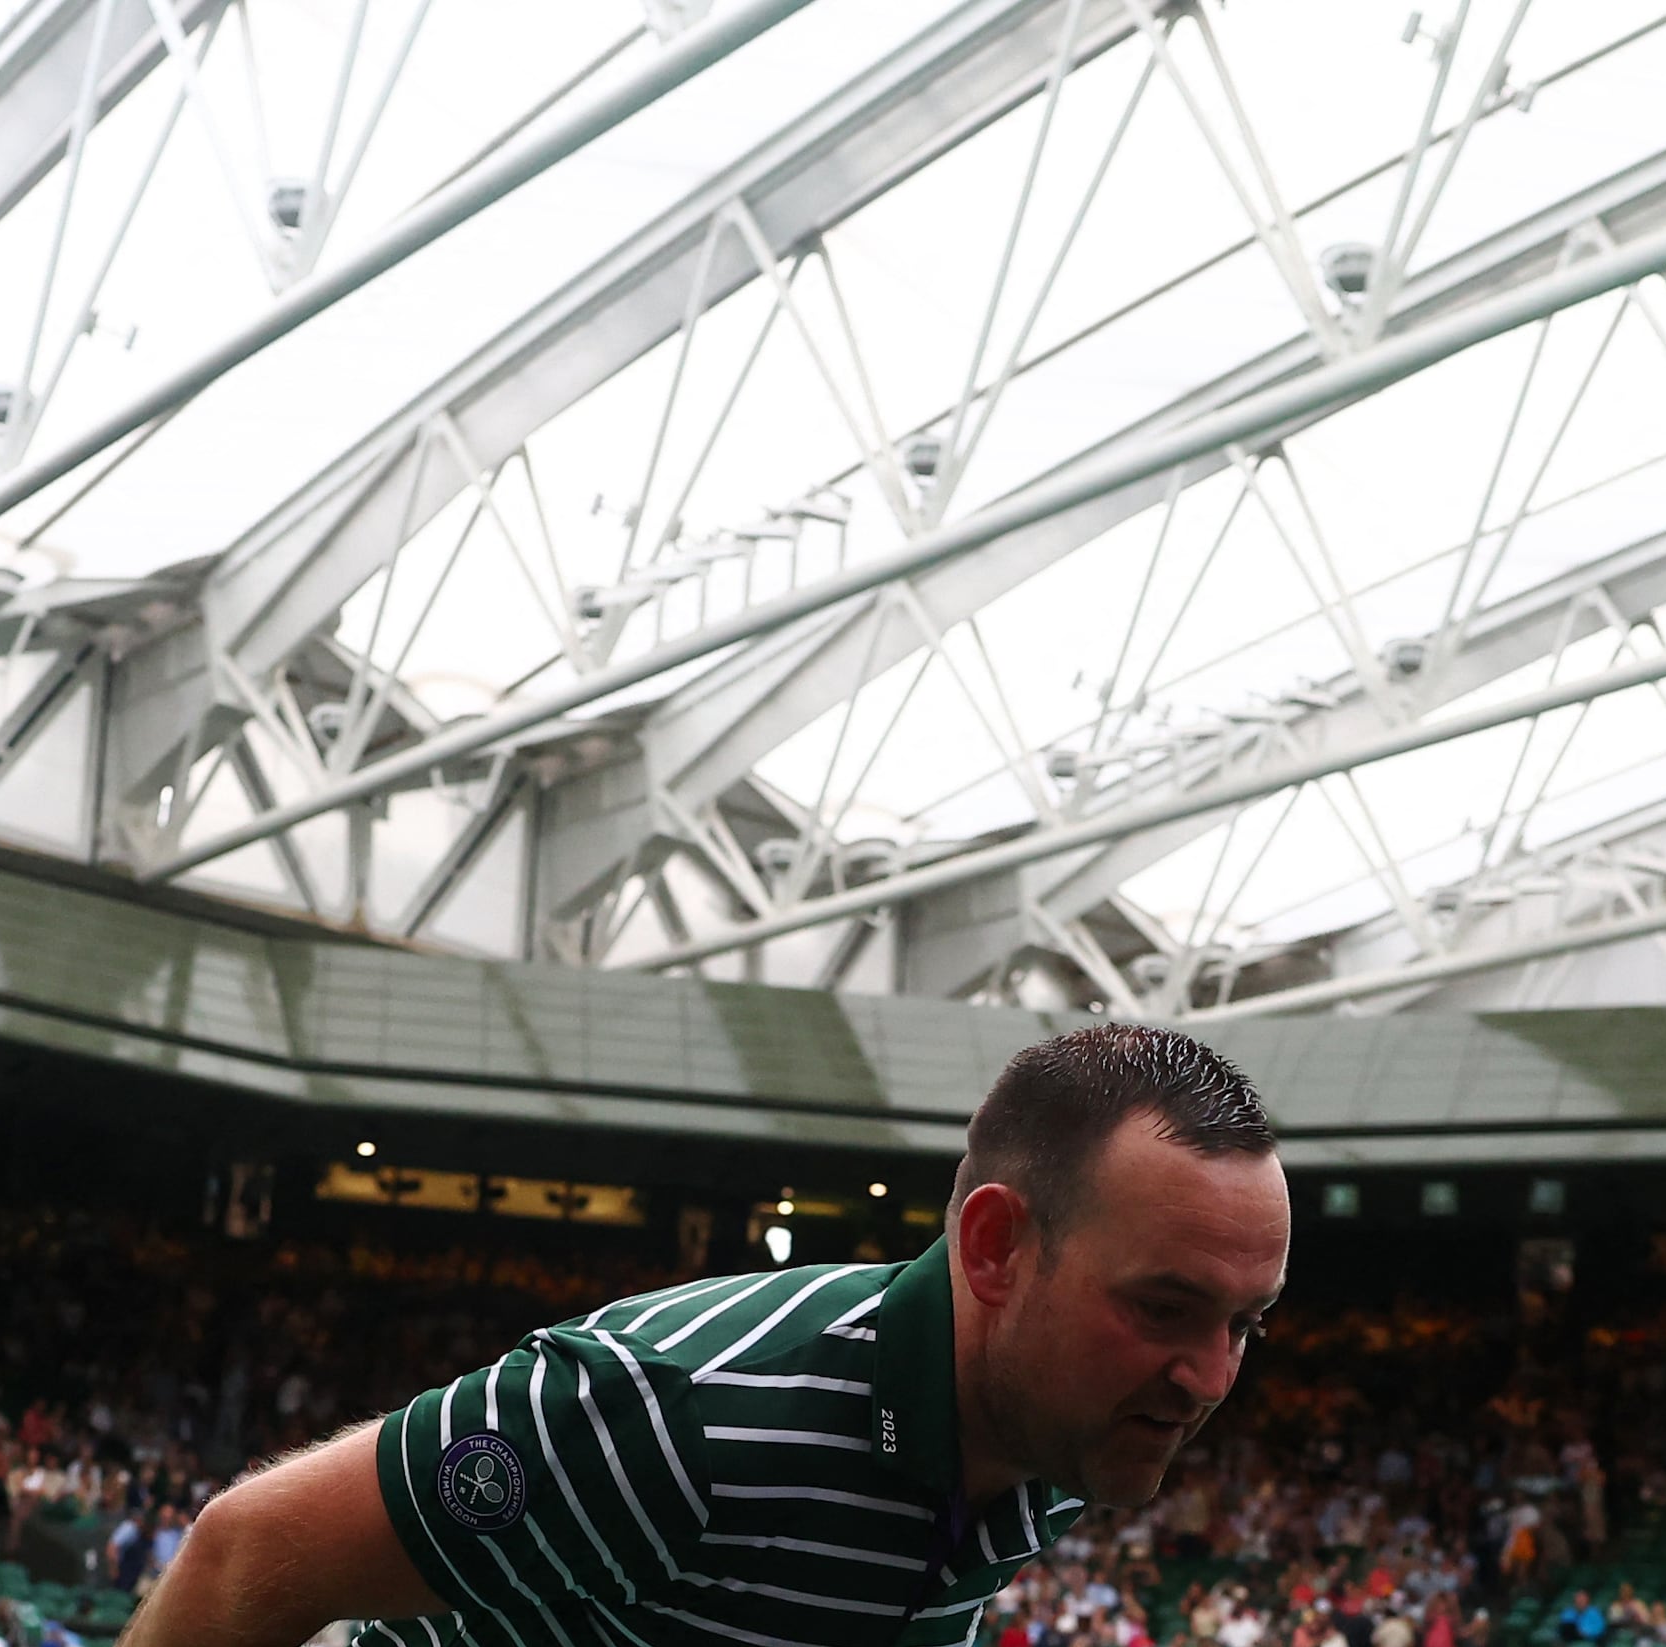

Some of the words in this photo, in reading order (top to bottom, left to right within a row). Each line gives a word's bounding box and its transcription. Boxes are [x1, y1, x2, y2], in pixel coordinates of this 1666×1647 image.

[881, 1408, 897, 1453] 2023
[442, 1464, 478, 1526] WIMBLEDON
[468, 1439, 488, 1449] THE
[490, 1441, 521, 1521] CHAMPIONSHIPS
